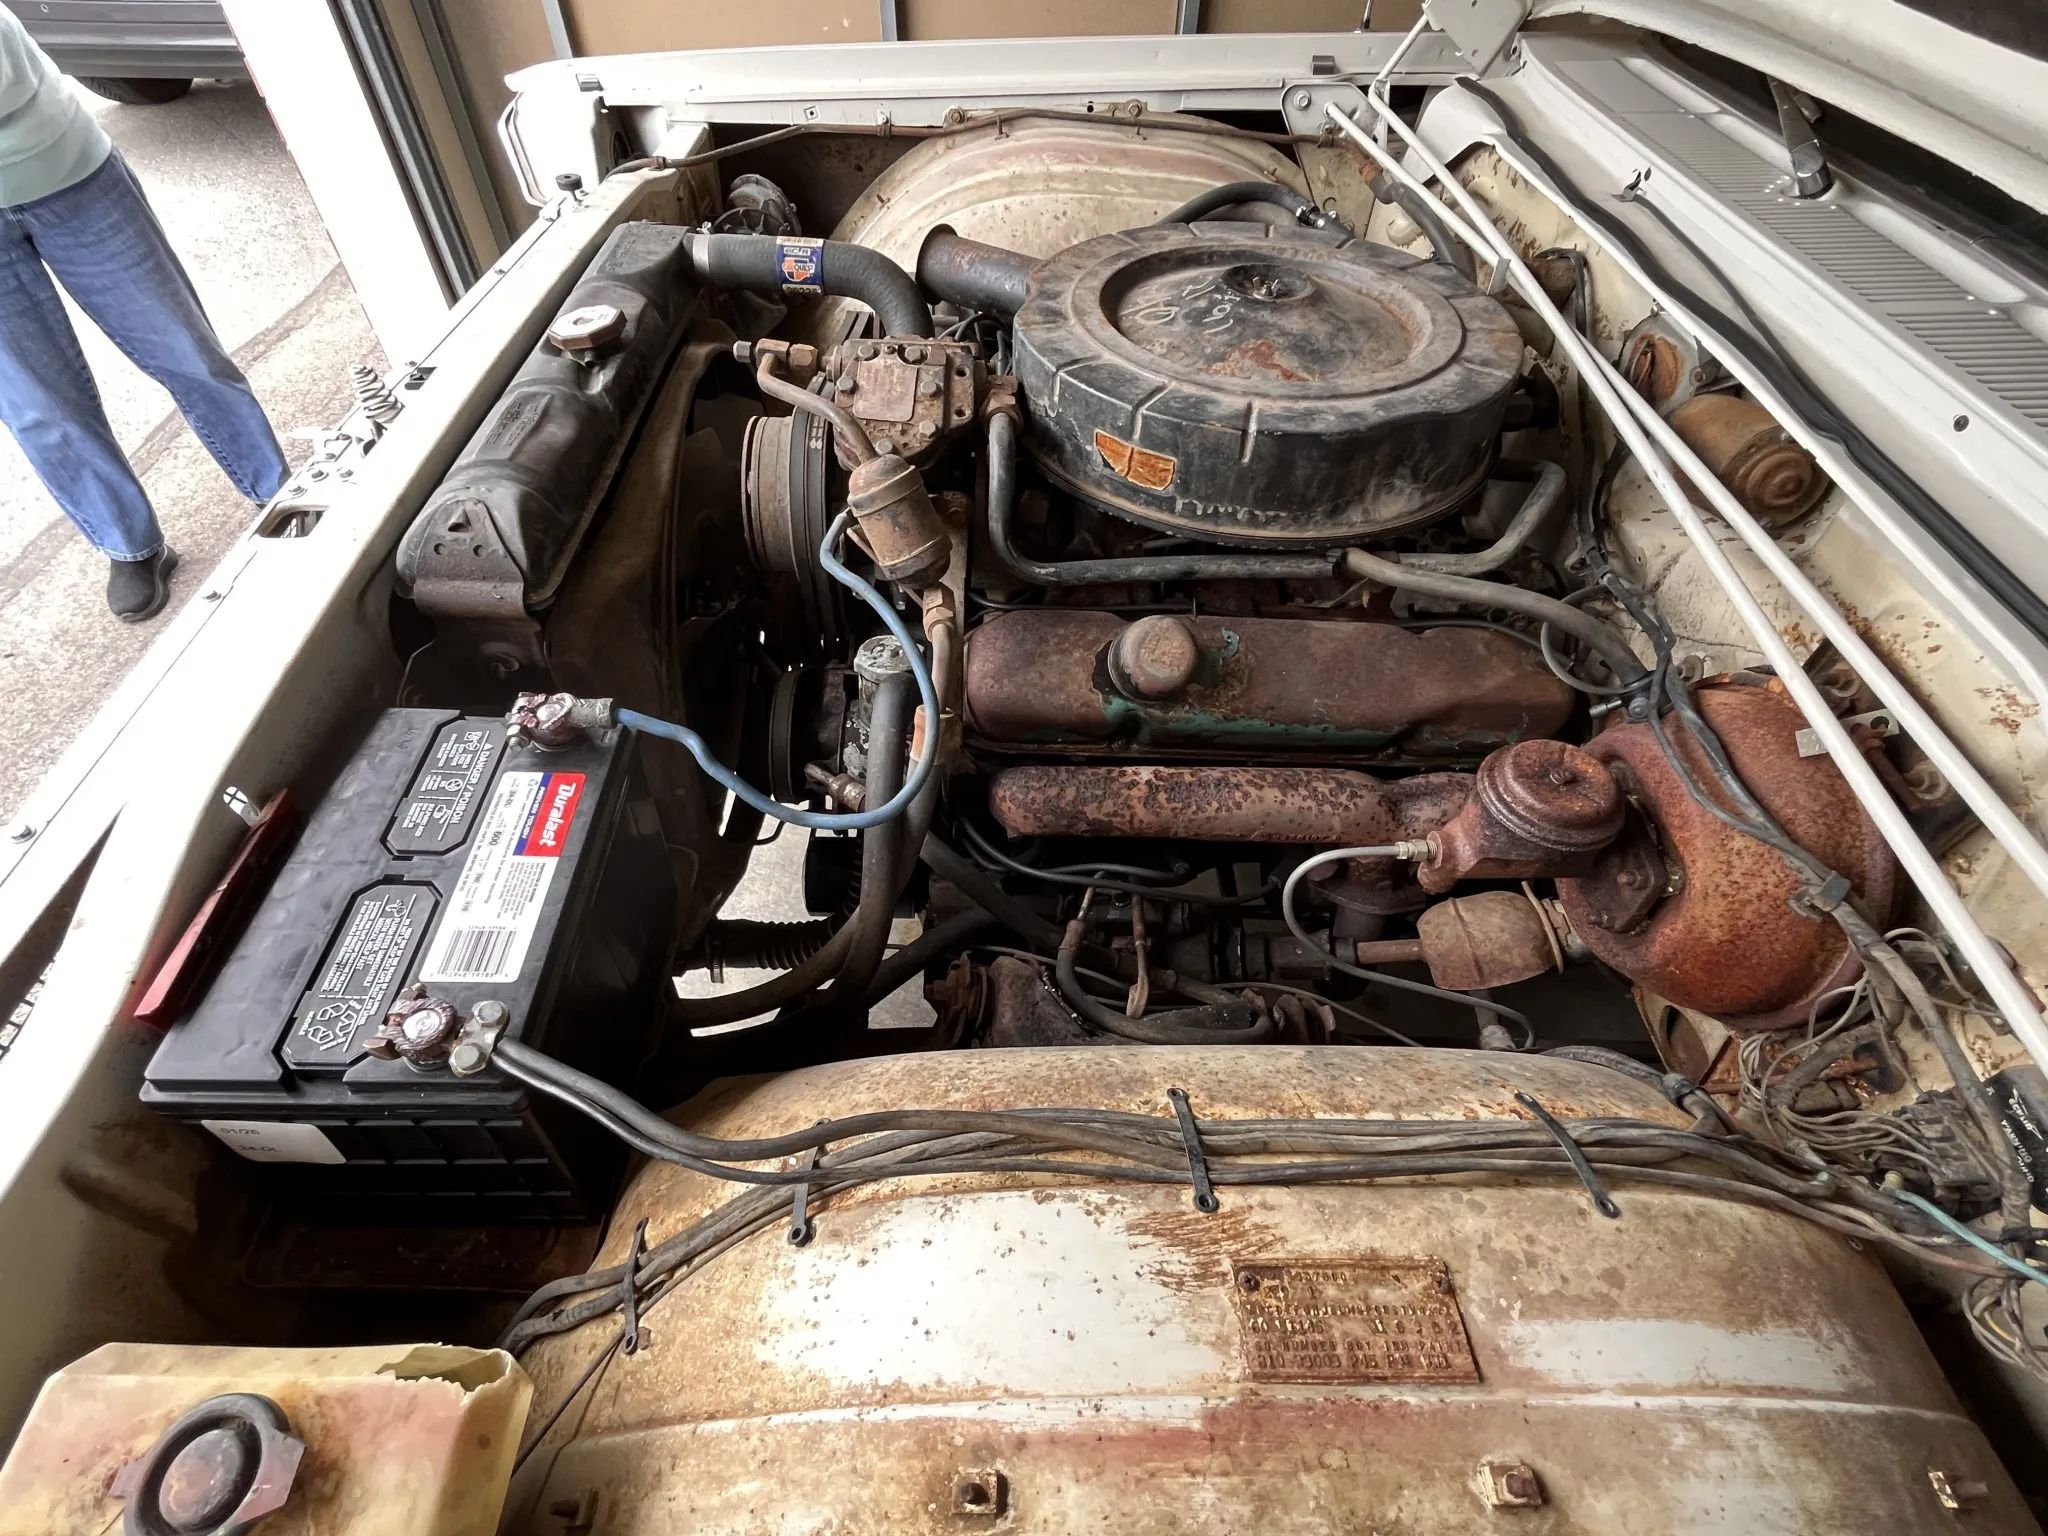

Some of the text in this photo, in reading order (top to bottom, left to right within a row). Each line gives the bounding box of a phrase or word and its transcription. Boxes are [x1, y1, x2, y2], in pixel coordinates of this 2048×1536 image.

[793, 262, 814, 273] QUEST
[467, 750, 490, 784] DANGER
[449, 790, 472, 824] POISON
[520, 785, 546, 839] PROVEN TOUGH
[536, 782, 577, 846] Duralast
[487, 830, 502, 845] 600
[379, 917, 393, 932] WITH
[354, 917, 386, 970] MEDICAL HELP FAST
[361, 917, 401, 987] FLUSH EYES IMMEDIATELY
[364, 953, 376, 964] GET
[297, 1010, 316, 1035] RECYCLE
[1282, 1340, 1337, 1352] NUMBER
